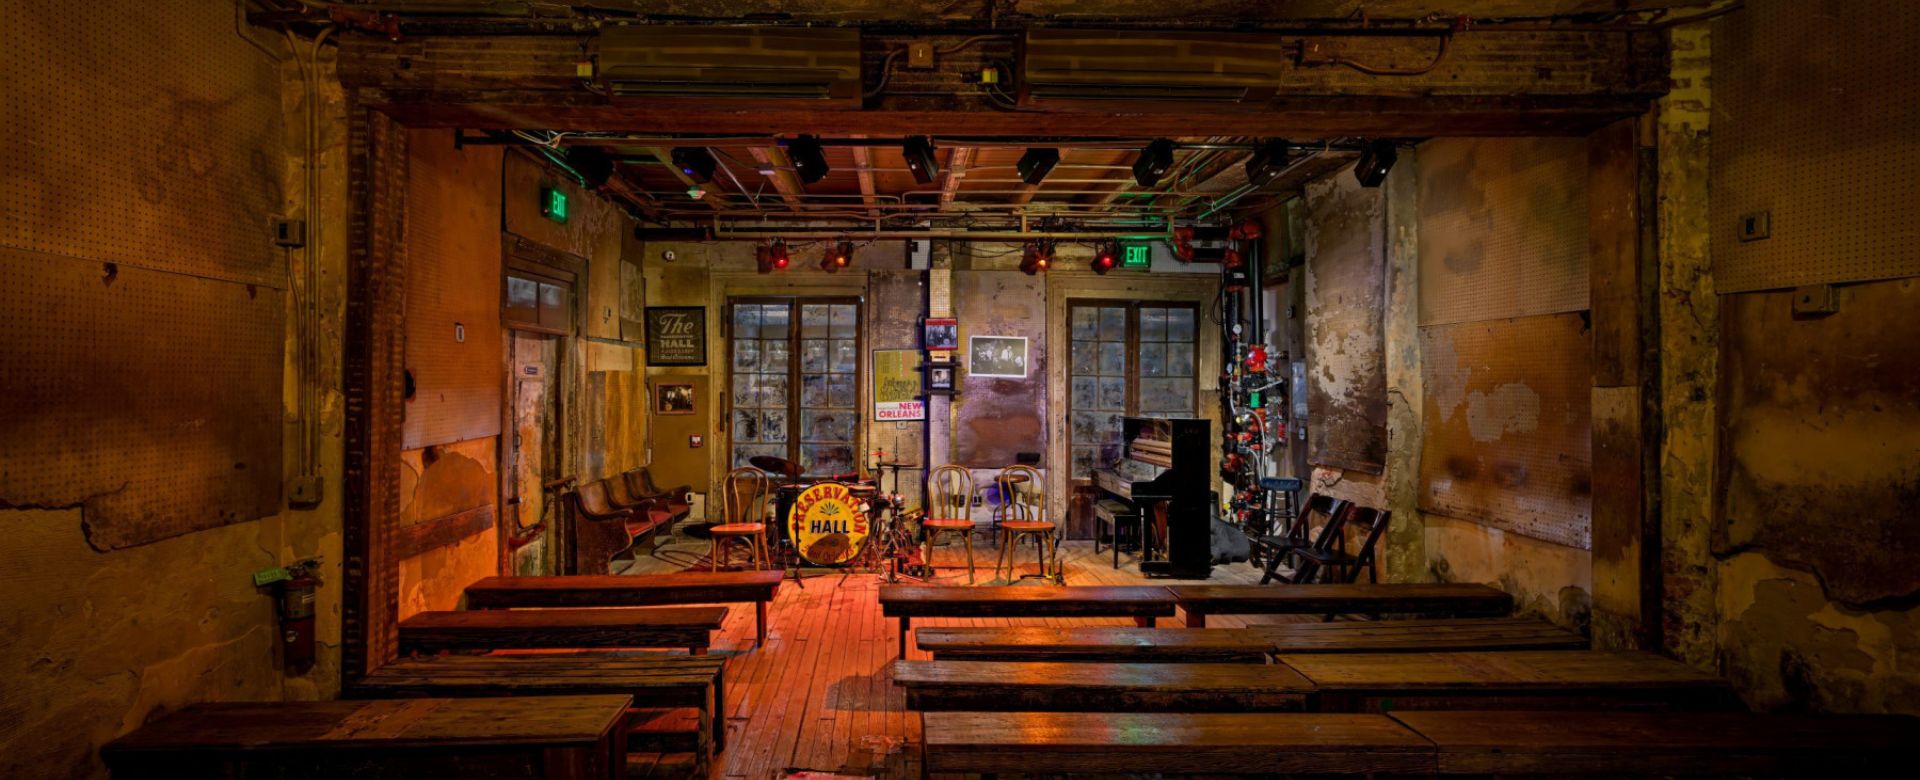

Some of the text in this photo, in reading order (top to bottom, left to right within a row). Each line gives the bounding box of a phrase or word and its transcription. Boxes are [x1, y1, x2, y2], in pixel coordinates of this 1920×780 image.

[553, 191, 566, 218] EXIT
[1127, 246, 1148, 263] EXIT
[660, 313, 694, 334] The
[660, 339, 695, 348] HALL
[899, 402, 922, 410] NEW
[878, 410, 921, 418] ORLEANS
[811, 520, 850, 534] HALL
